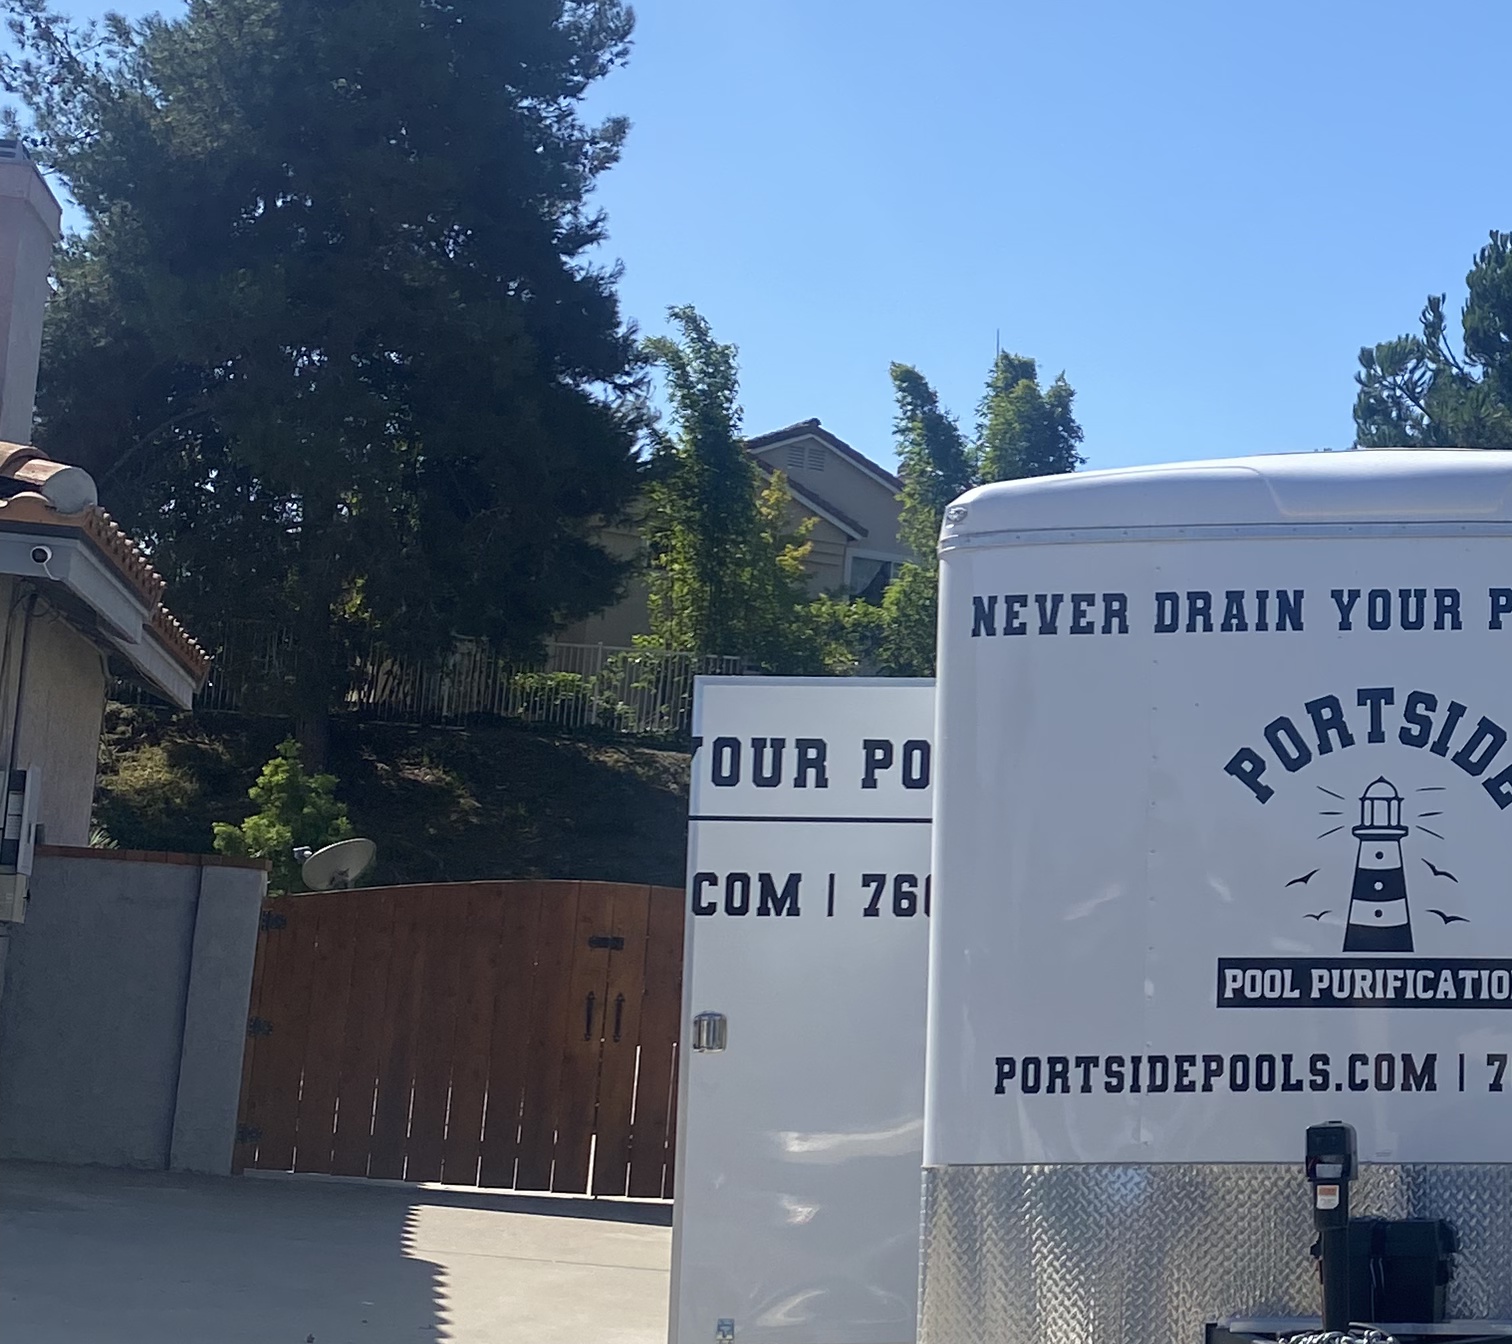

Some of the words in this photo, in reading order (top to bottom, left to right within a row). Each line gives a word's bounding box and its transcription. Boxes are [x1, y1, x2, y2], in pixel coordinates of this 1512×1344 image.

[971, 592, 1130, 638] NEVER
[1153, 589, 1305, 634] DRAIN
[1330, 588, 1463, 631] YOUR
[691, 871, 802, 917] COM
[861, 873, 931, 918] 76
[1223, 968, 1301, 999] POOL
[994, 1053, 1438, 1095] PORTSIDEPOOLS.COM
